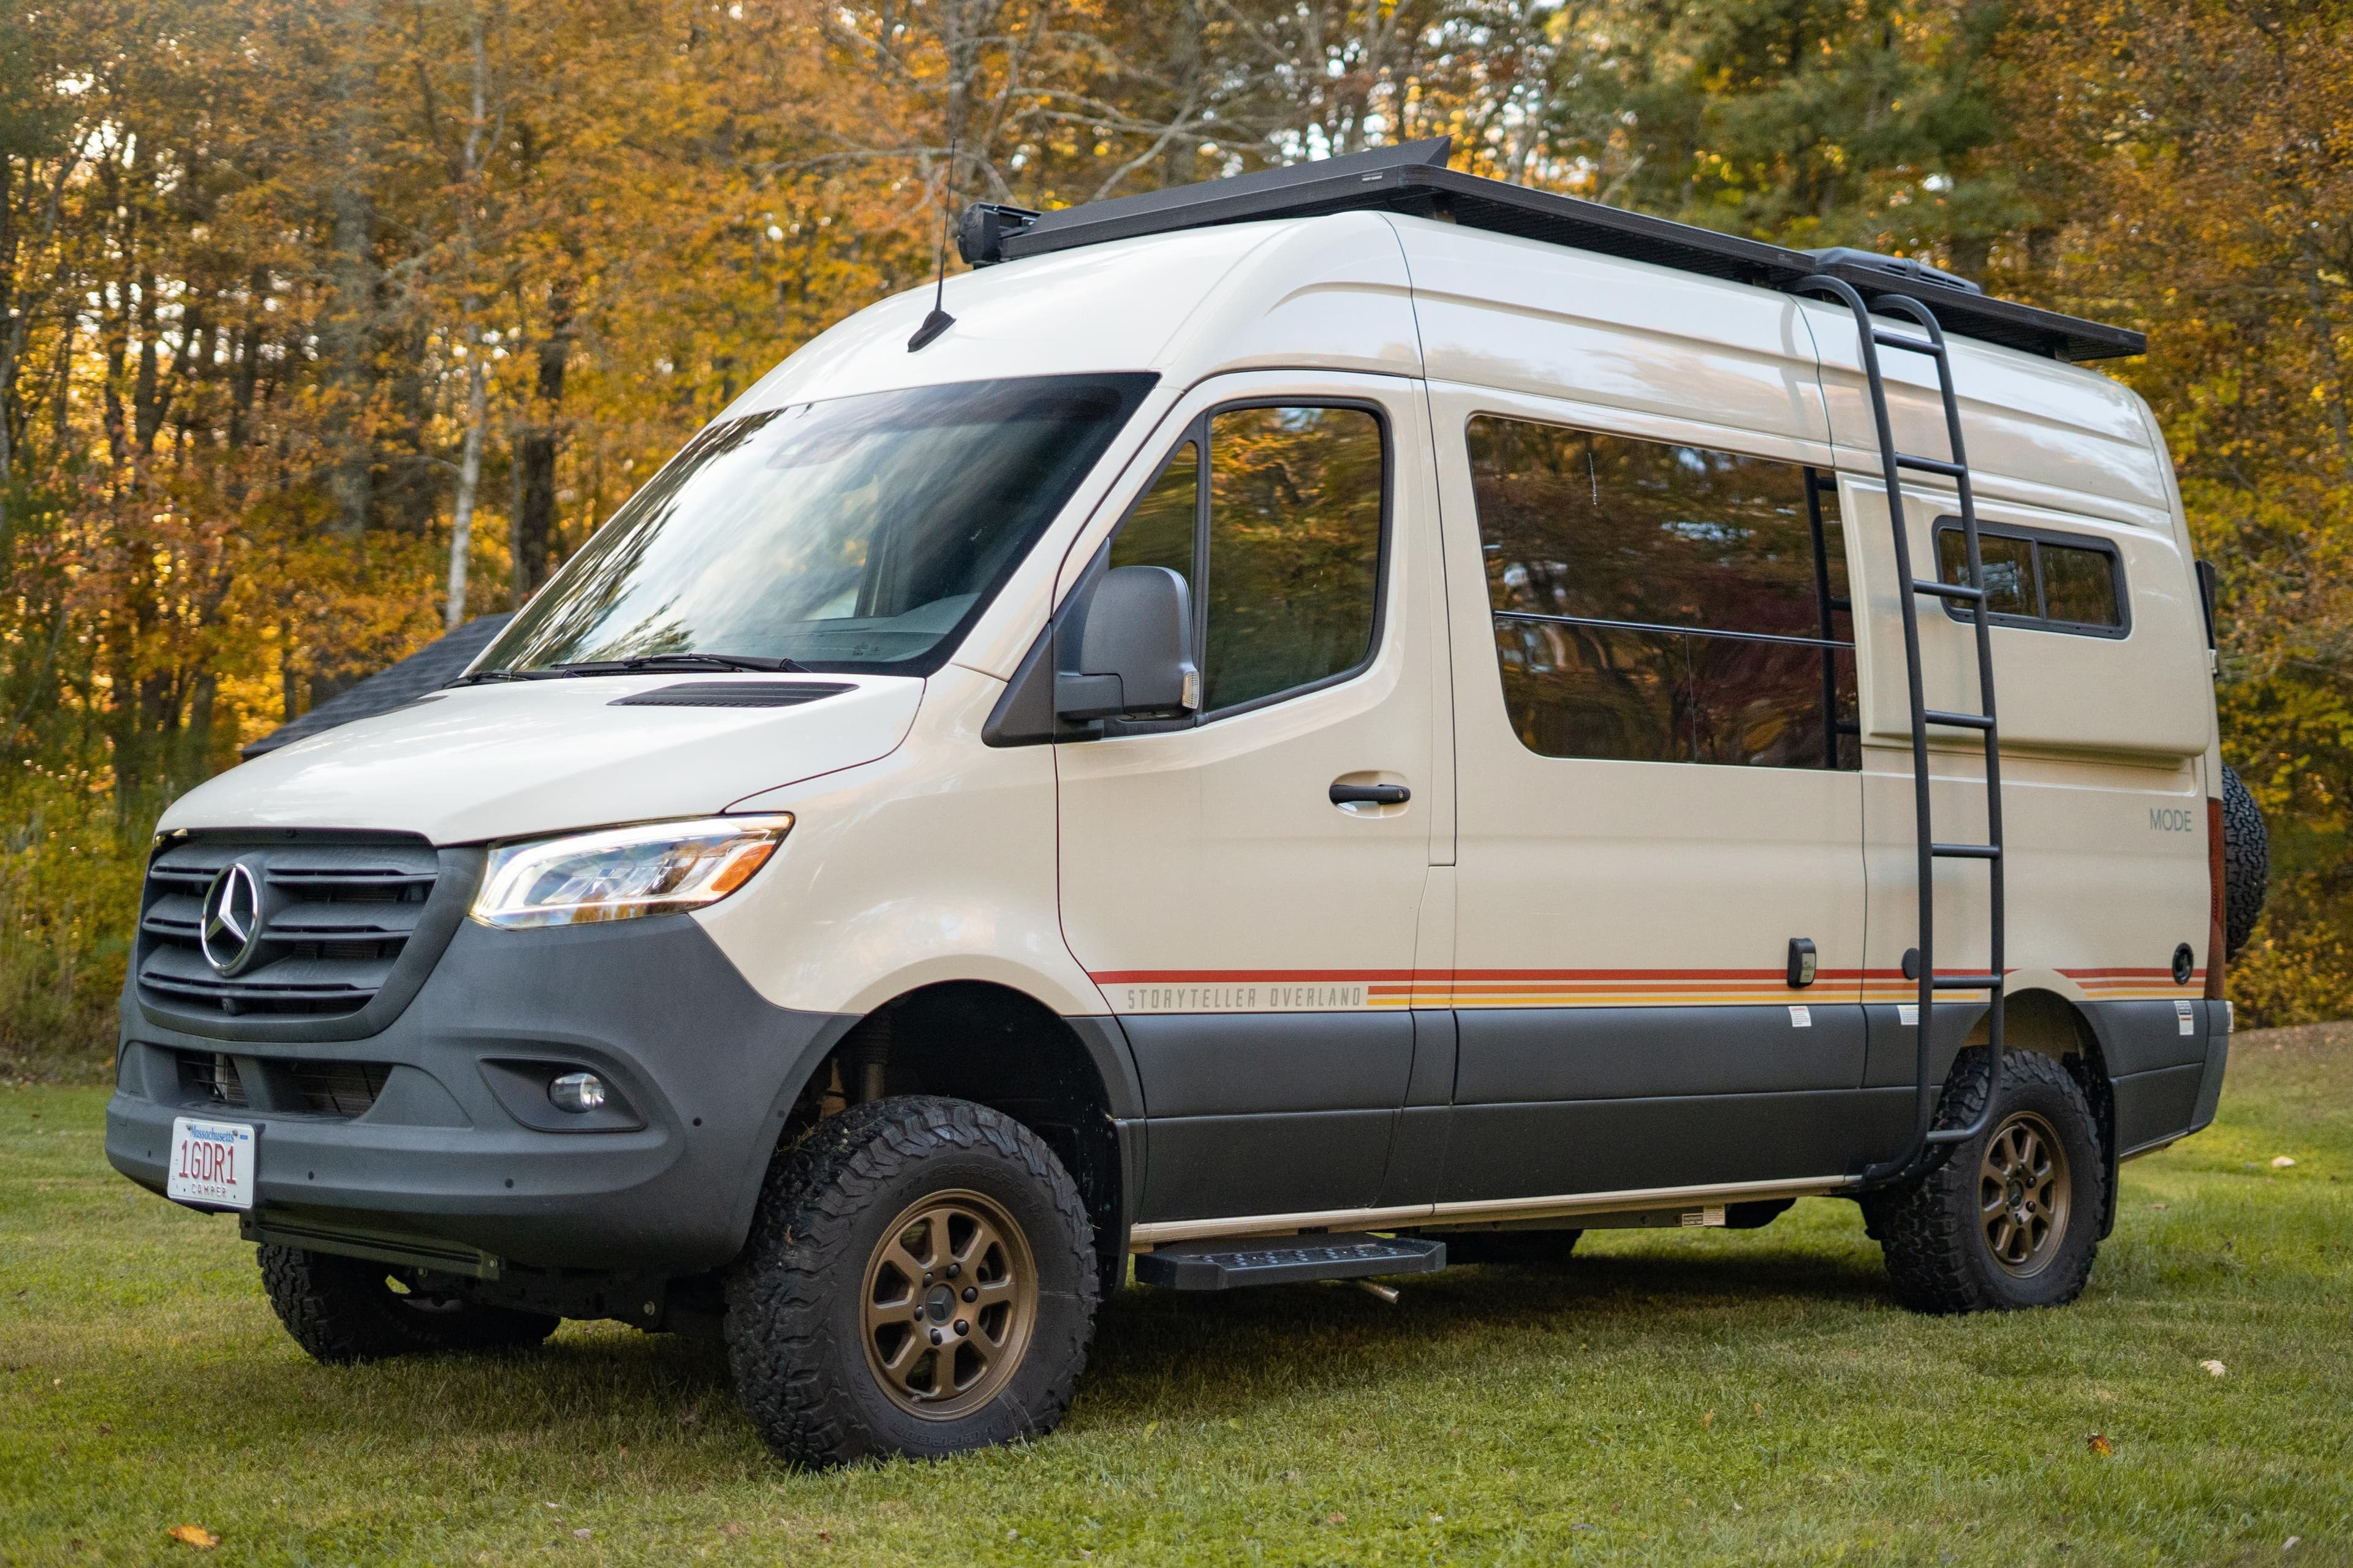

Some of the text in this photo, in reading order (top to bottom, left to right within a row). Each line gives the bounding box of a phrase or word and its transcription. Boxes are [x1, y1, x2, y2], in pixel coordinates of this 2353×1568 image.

[2150, 808, 2192, 831] MODE
[1128, 987, 1361, 1009] STORYTELLER OVERLAND
[190, 1124, 235, 1143] Massachusetts
[179, 1139, 237, 1184] 1GDR1
[192, 1183, 227, 1197] CAMPER
